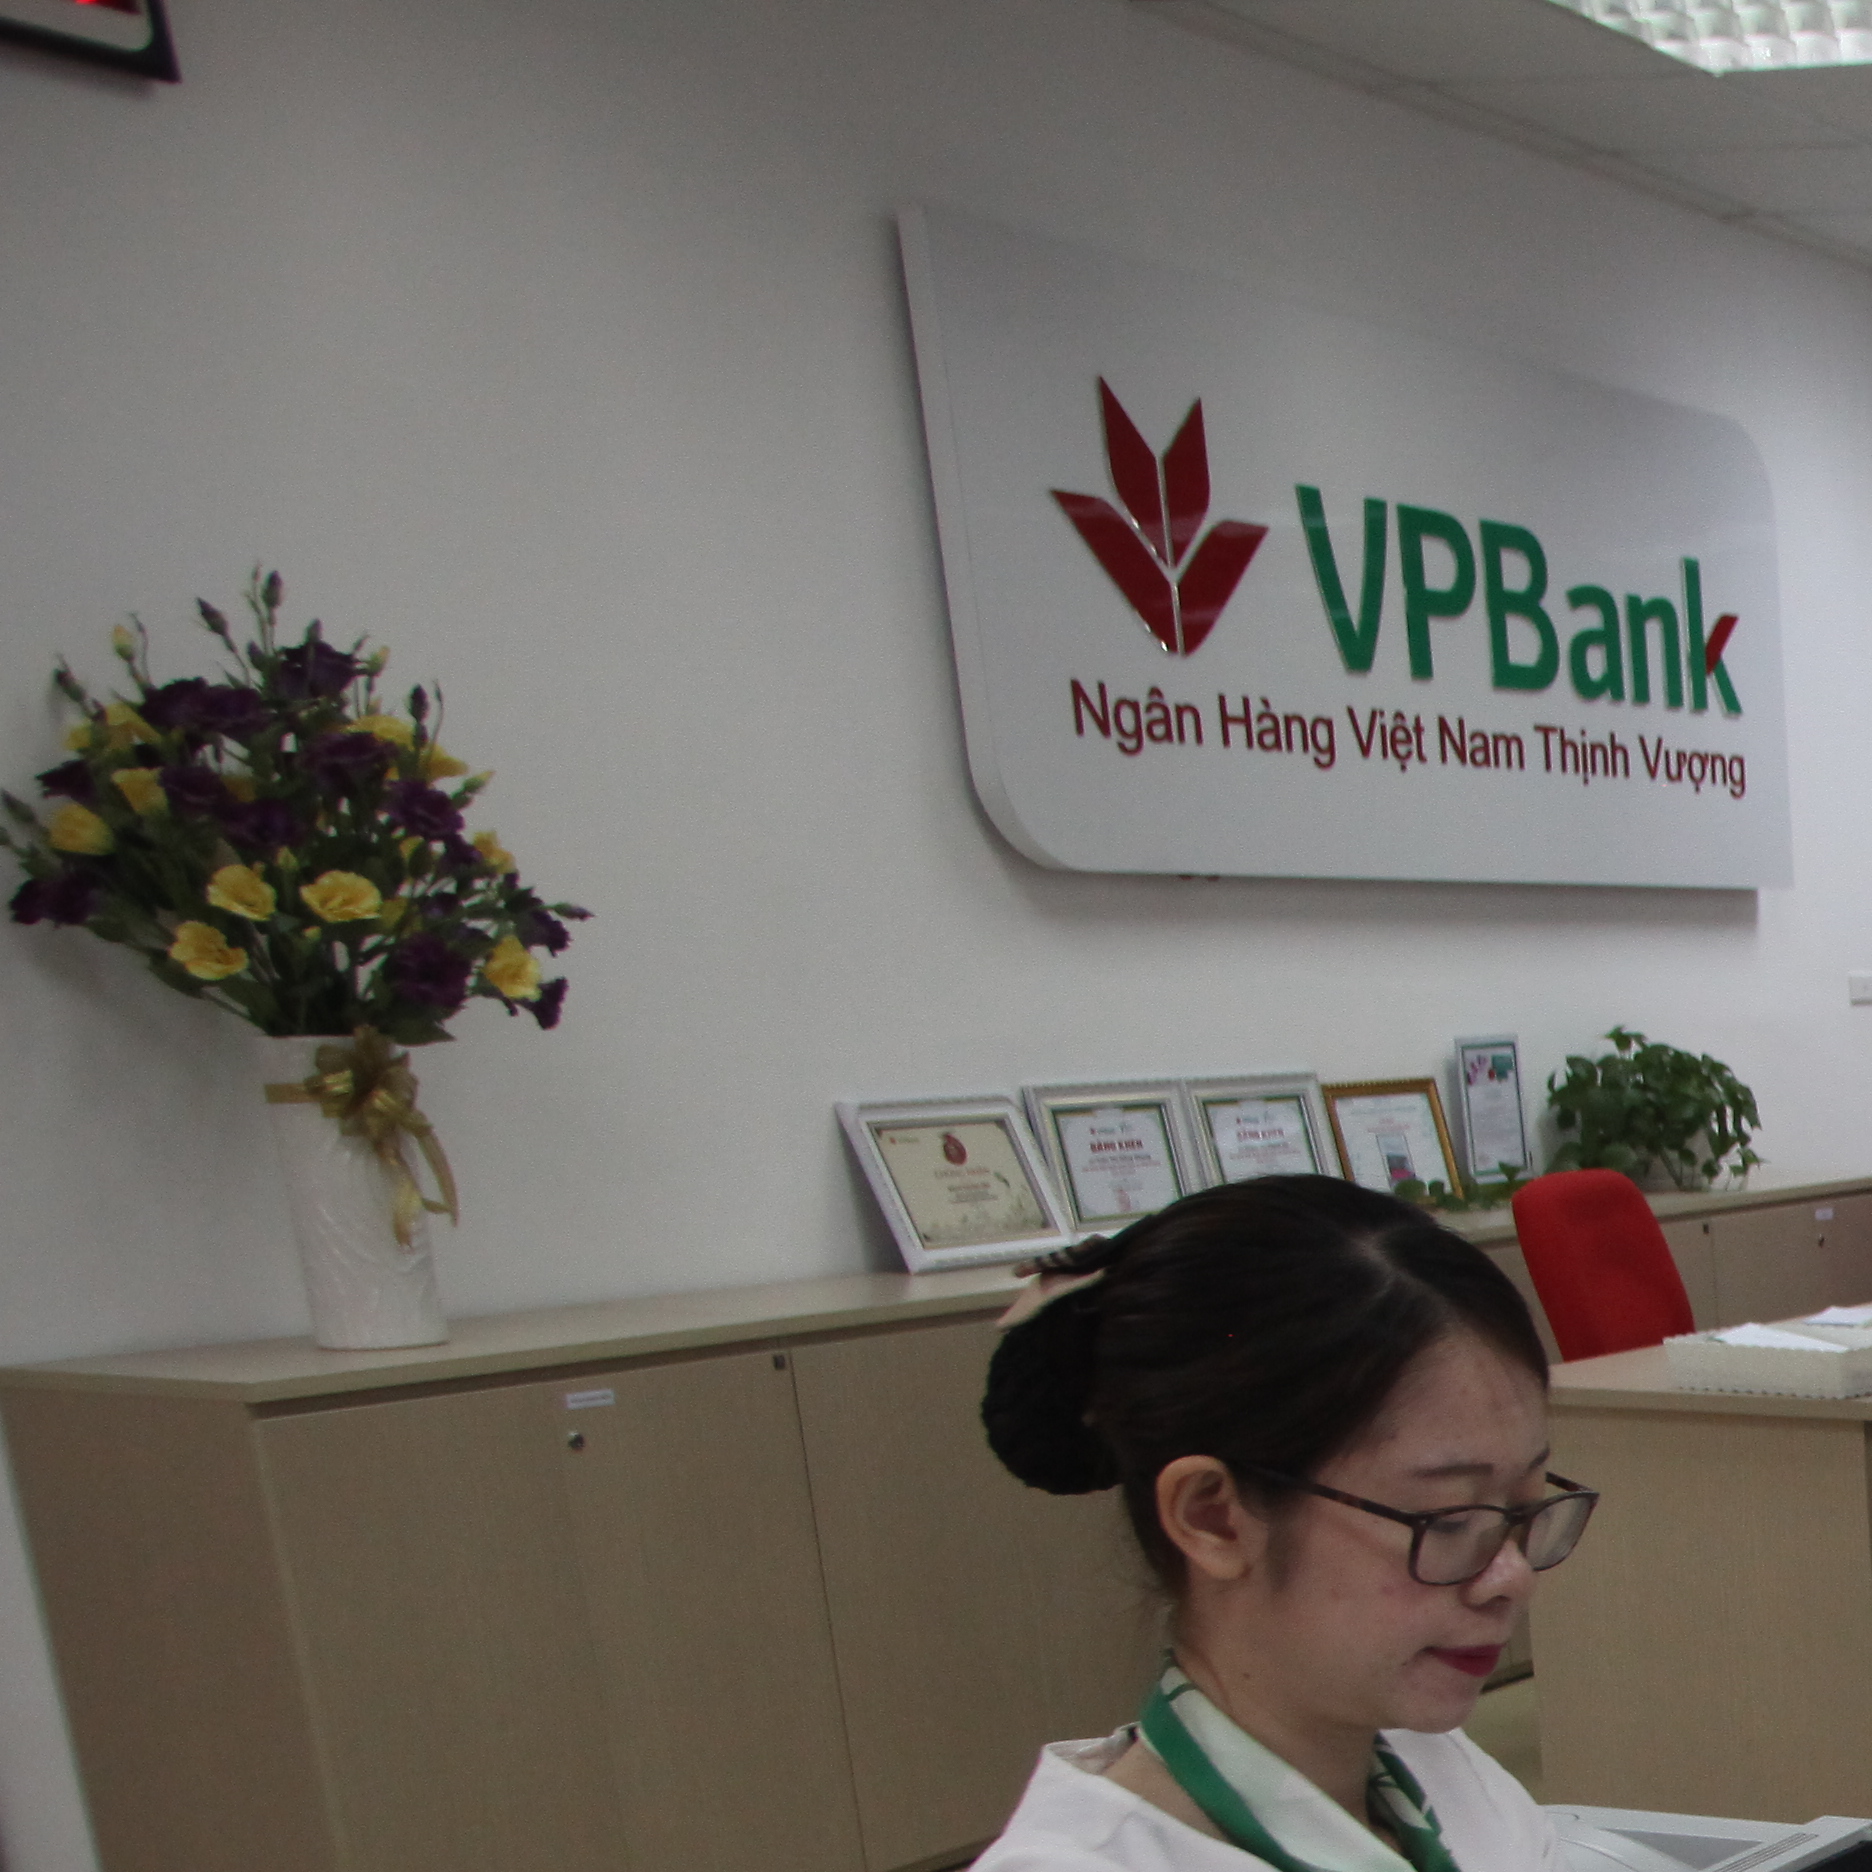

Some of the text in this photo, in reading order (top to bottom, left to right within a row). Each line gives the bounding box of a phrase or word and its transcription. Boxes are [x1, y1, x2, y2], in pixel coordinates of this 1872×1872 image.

[1294, 481, 1743, 717] VPBank
[1070, 678, 1747, 798] Ngân Hàng Việt Nam Thịnh Vượng
